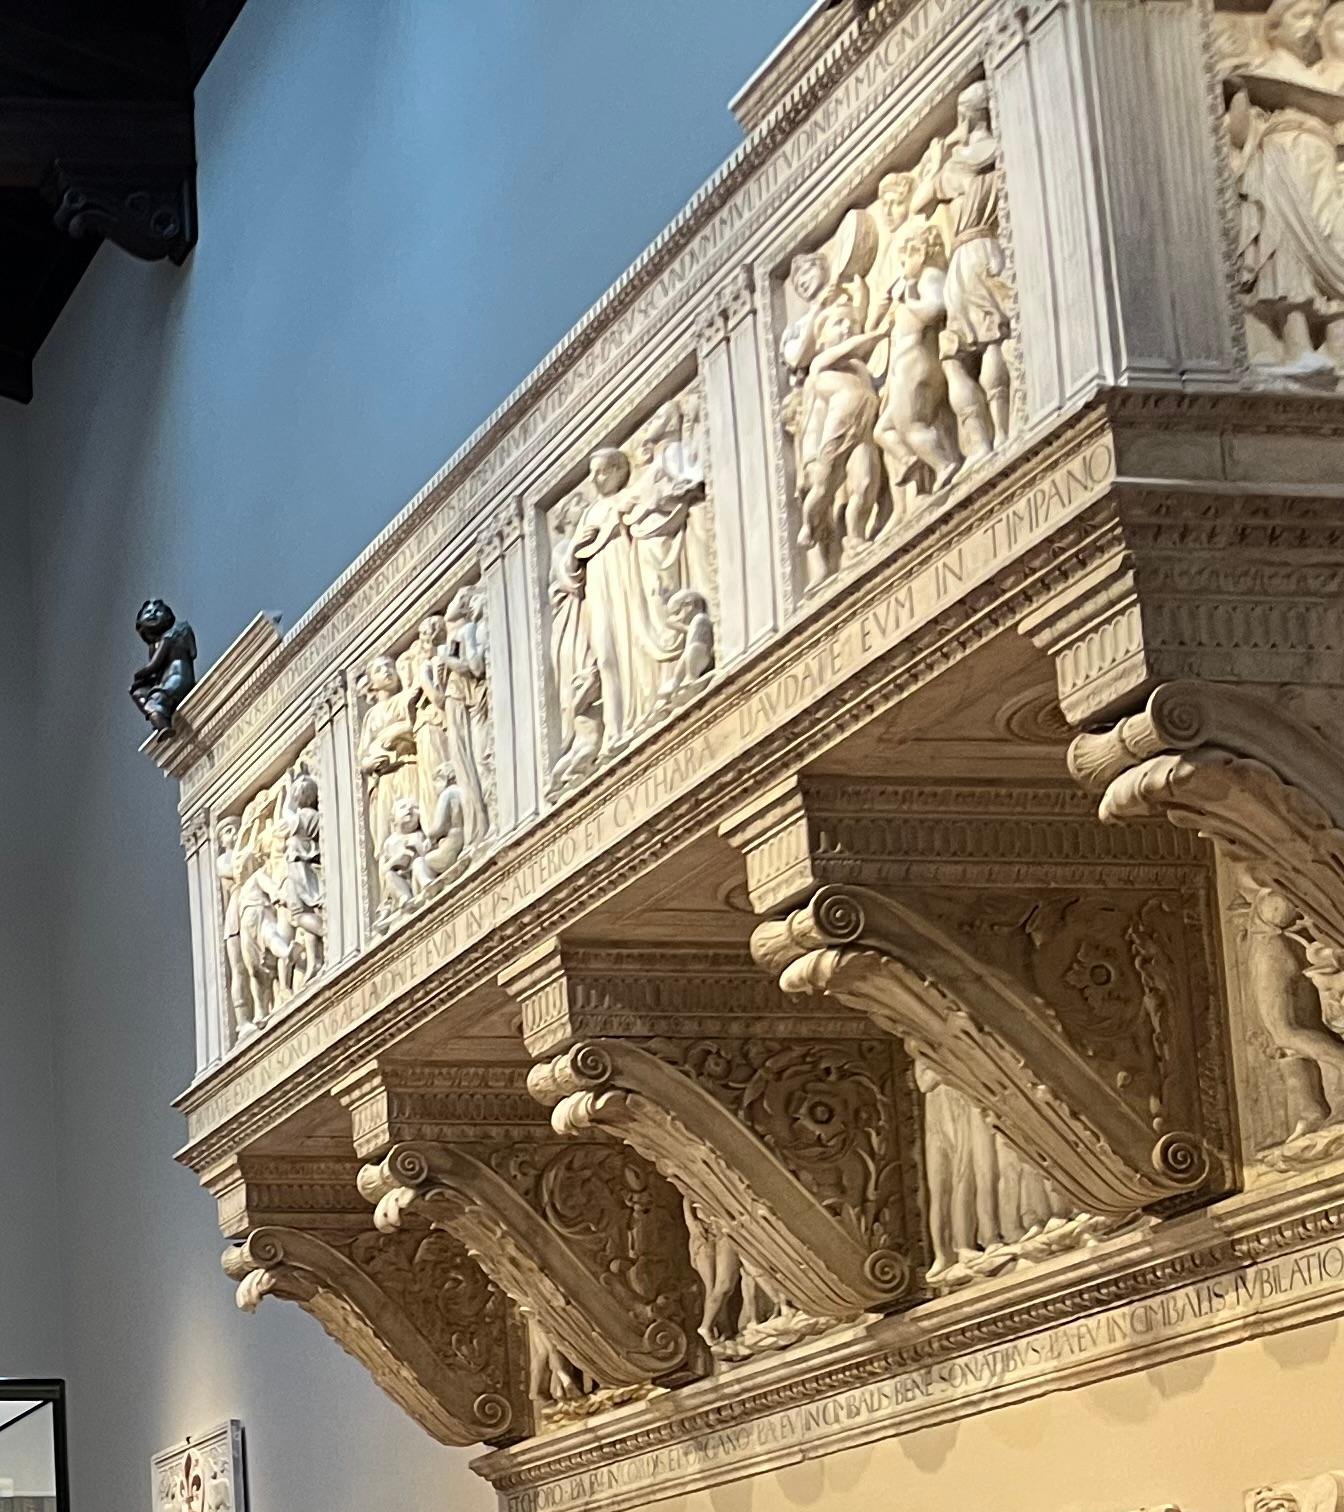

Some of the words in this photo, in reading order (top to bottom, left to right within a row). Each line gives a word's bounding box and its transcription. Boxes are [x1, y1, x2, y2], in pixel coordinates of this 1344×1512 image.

[490, 832, 578, 919] PSALTERIO
[582, 810, 607, 853] ET
[611, 731, 715, 832] CYTHARA
[736, 636, 844, 743] LAVDATE
[858, 582, 917, 655] EVM
[932, 545, 968, 602] IN
[982, 438, 1113, 567] TIMPANO
[1129, 1279, 1226, 1338] CIMBALIS
